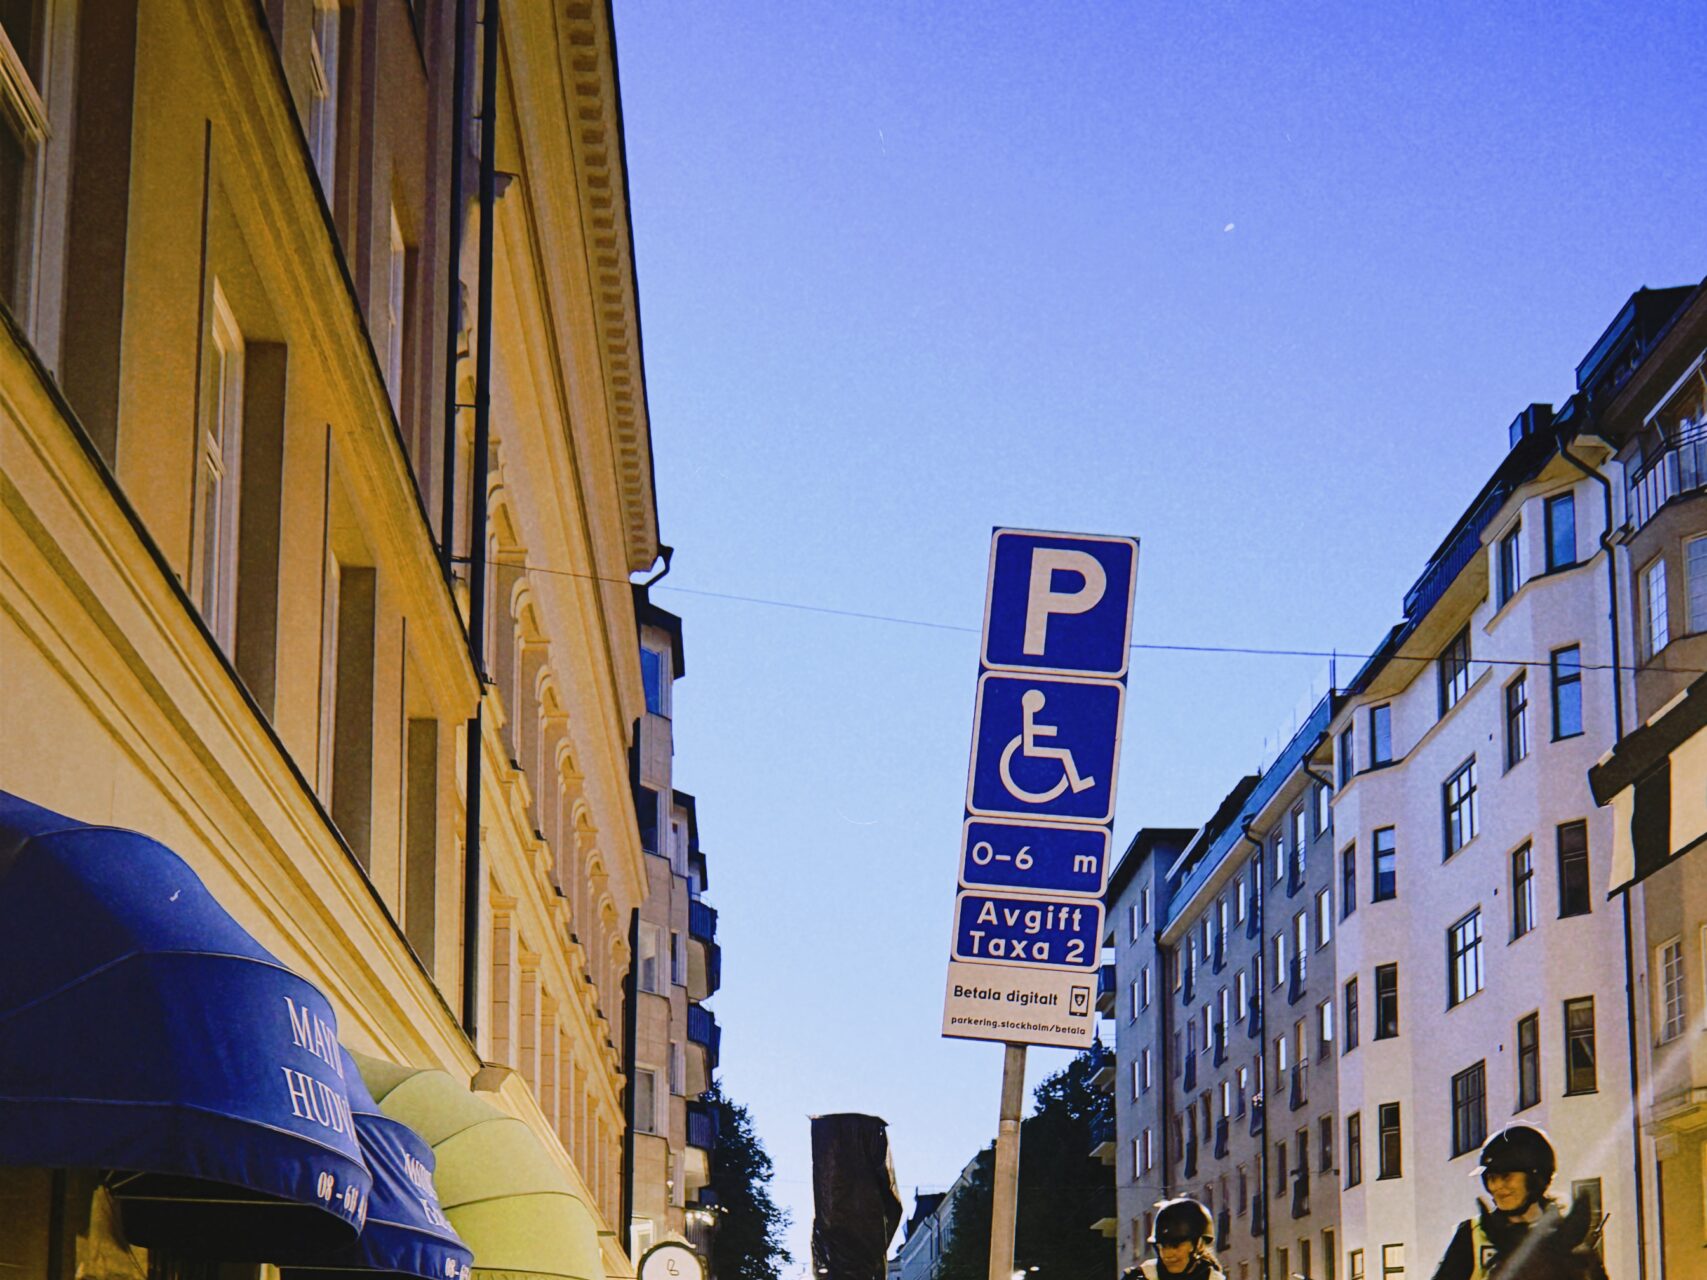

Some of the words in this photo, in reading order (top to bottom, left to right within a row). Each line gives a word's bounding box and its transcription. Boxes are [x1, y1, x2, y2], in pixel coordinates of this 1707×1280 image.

[1023, 547, 1107, 656] P
[1073, 854, 1097, 874] m
[976, 901, 1082, 934] Avgift
[969, 931, 1050, 960] Taxa
[1065, 939, 1085, 963] 2
[953, 985, 1001, 1001] Betala
[1006, 991, 1058, 1006] digitalt
[951, 1016, 1086, 1035] parkering.stockholm/betala
[317, 1171, 335, 1201] 08
